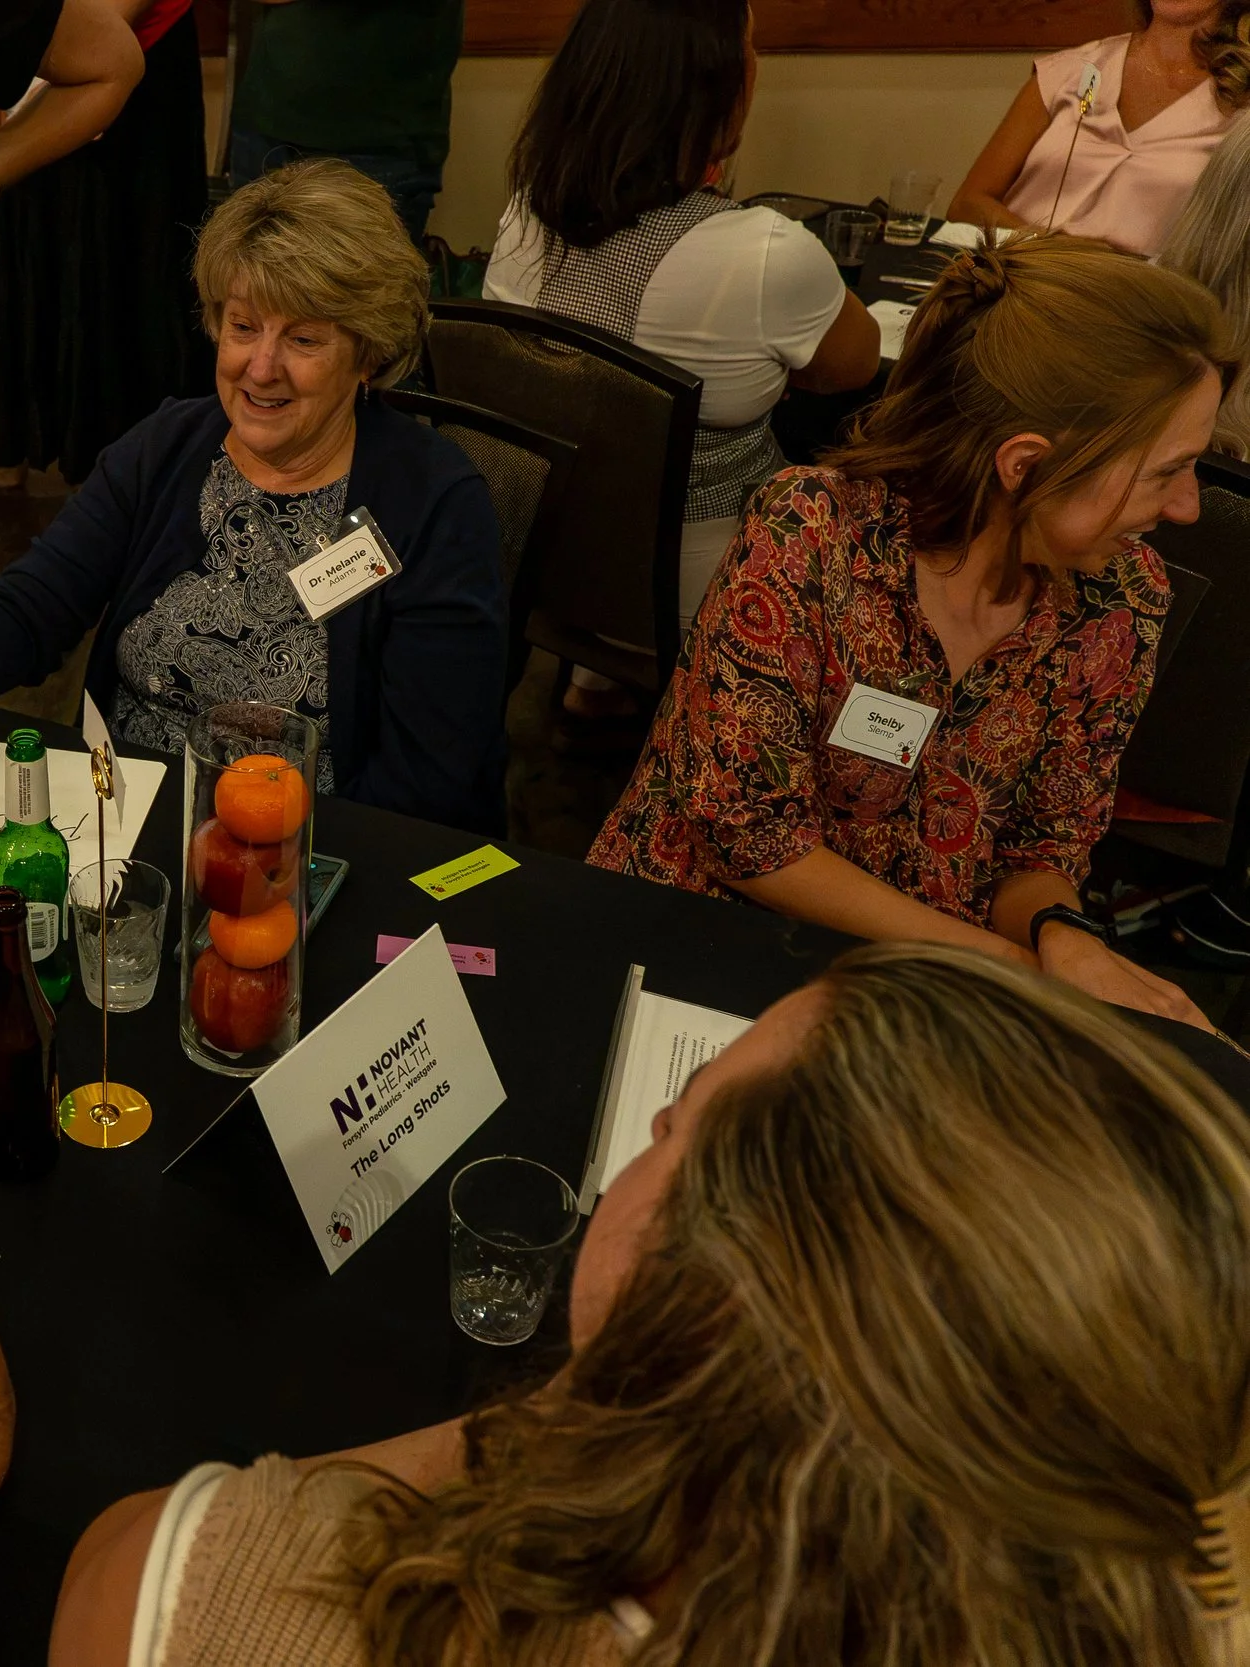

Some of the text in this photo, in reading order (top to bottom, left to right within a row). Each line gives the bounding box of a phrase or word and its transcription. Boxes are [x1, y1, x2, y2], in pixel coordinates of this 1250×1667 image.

[308, 548, 367, 588] Dr. Melanie
[329, 567, 357, 587] Adams
[867, 711, 905, 732] Shelby
[867, 724, 895, 740] Slemp
[369, 1018, 428, 1081] NOVANT
[376, 1041, 431, 1099] HEALTH
[342, 1122, 370, 1150] Forsyth
[368, 1091, 403, 1126] Pediatrics
[405, 1058, 438, 1090] Westgate
[350, 1080, 451, 1179] The Long Shots
